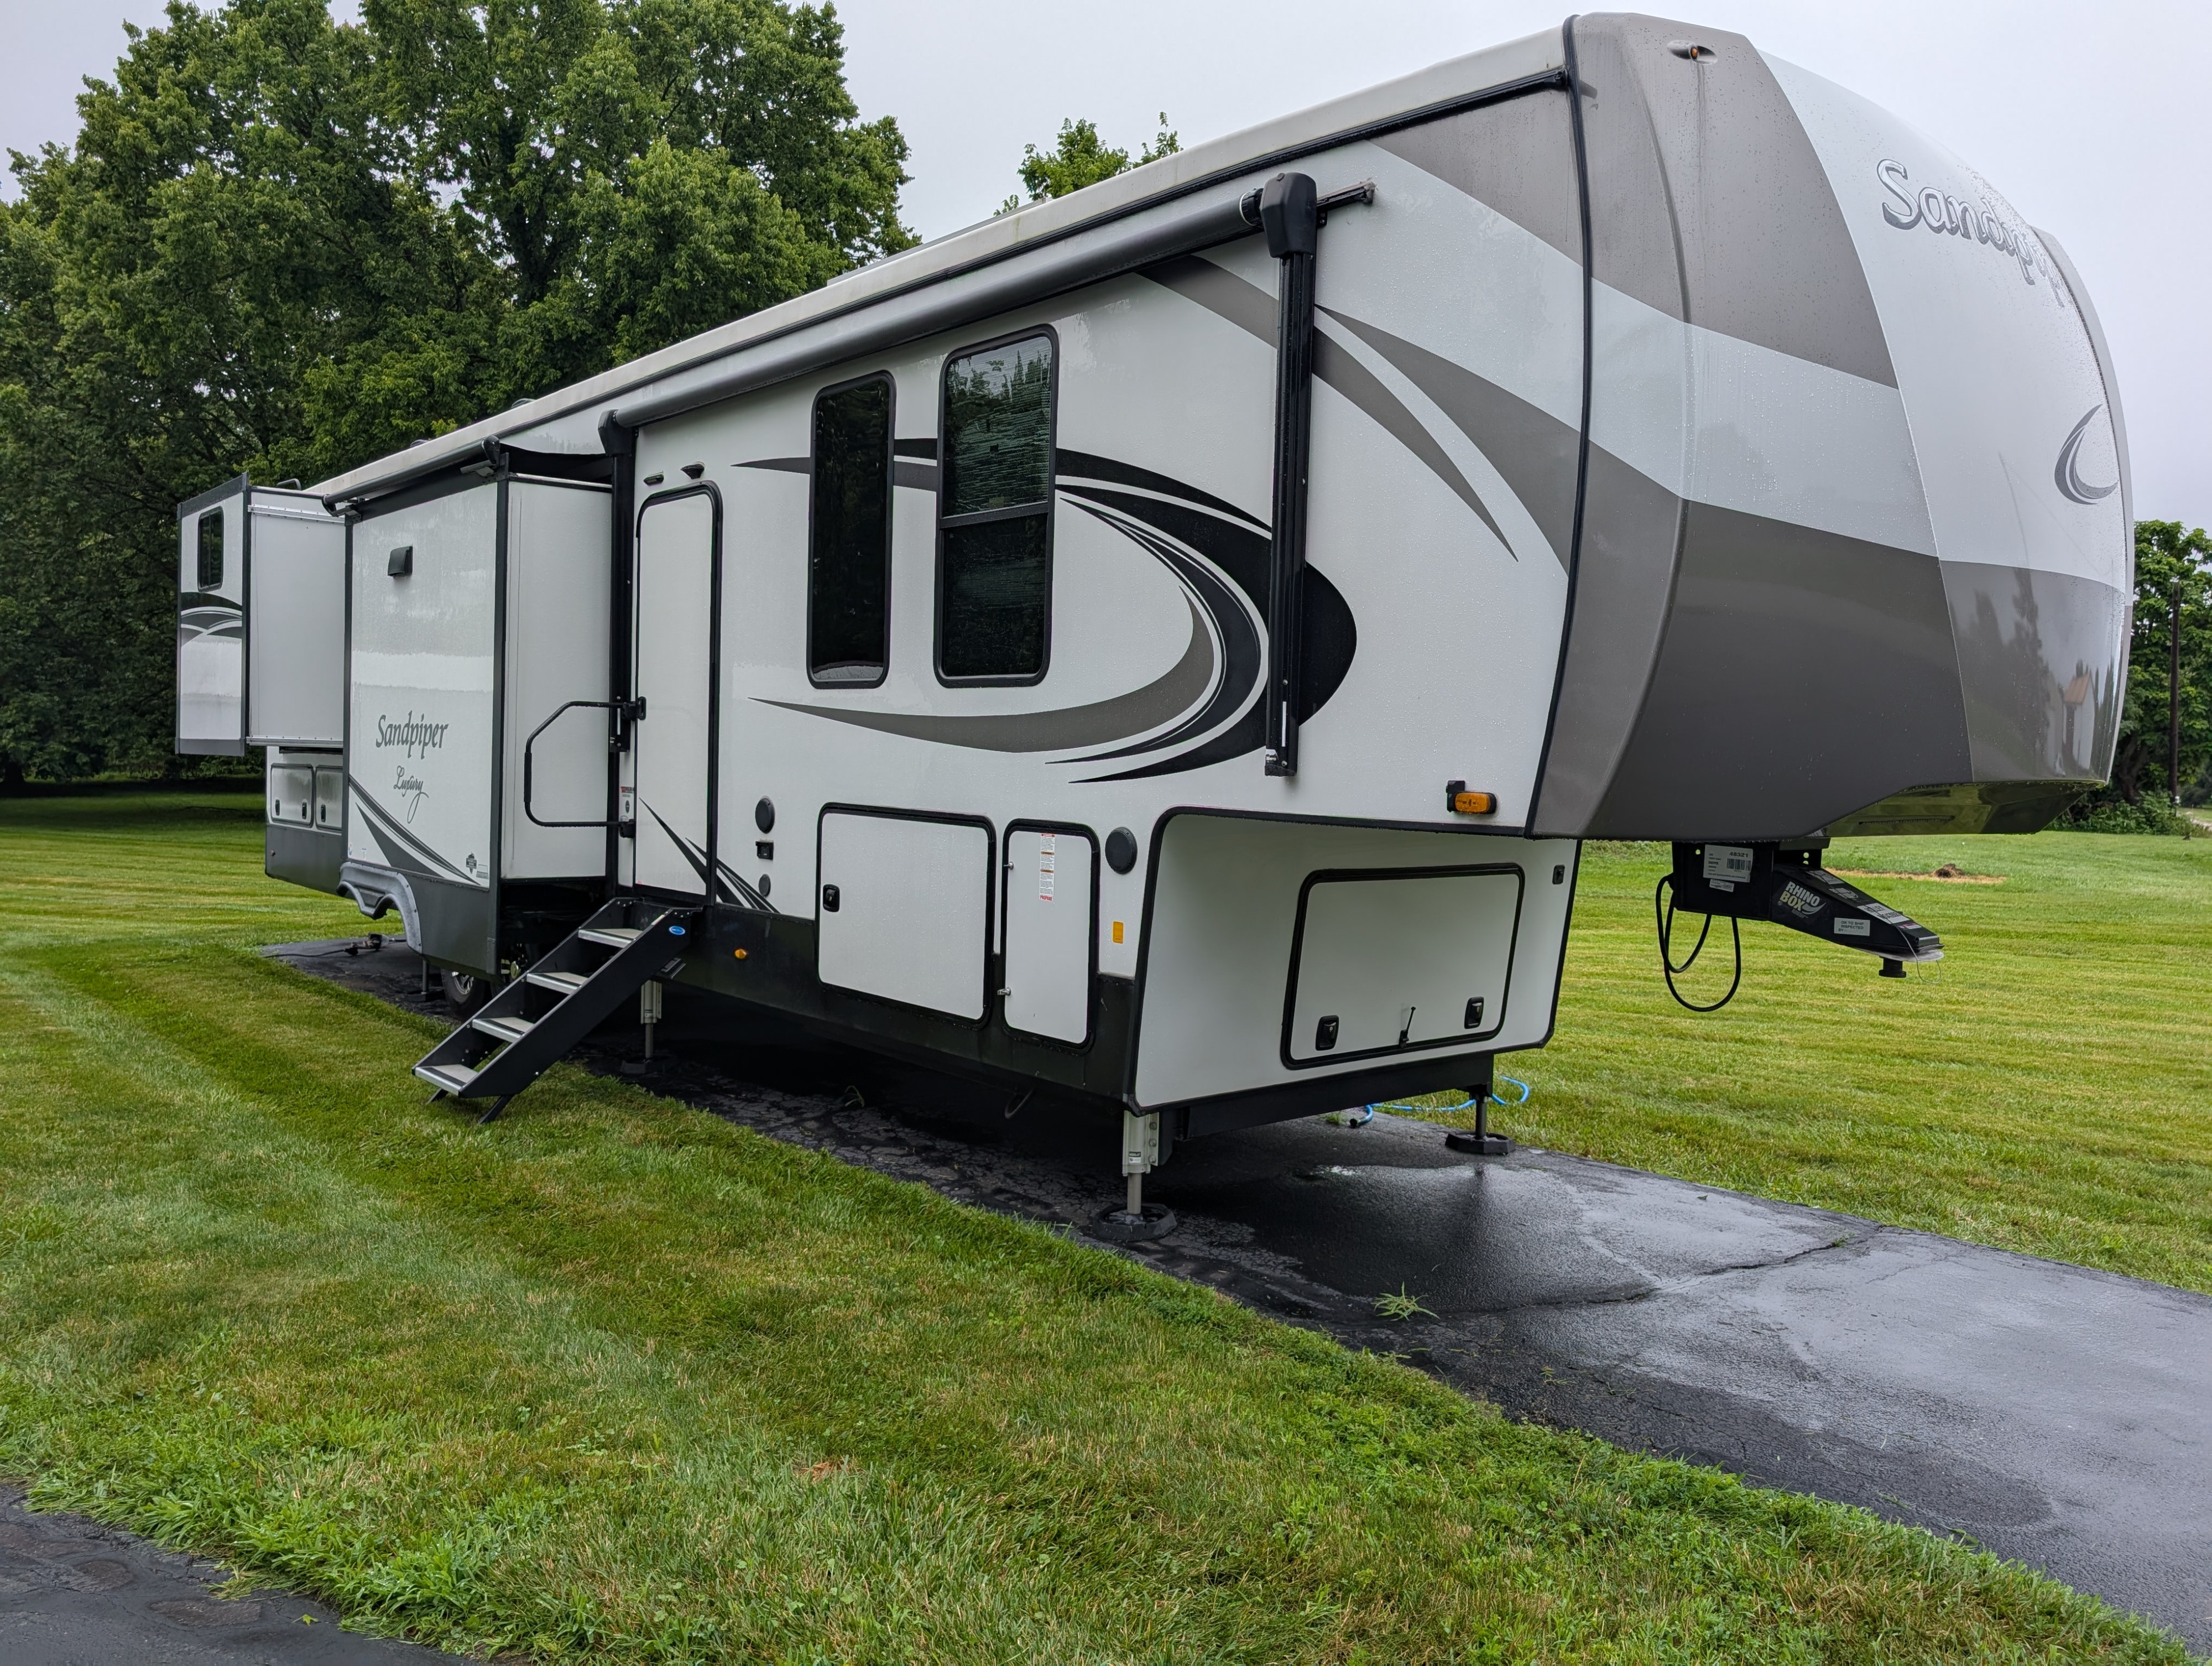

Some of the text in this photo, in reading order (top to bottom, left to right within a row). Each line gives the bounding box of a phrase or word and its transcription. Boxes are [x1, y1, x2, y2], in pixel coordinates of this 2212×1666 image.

[375, 710, 449, 760] Sandpiper
[393, 765, 429, 824] Luxury
[1780, 891, 1806, 911] BOX
[1785, 881, 1820, 907] RHINO
